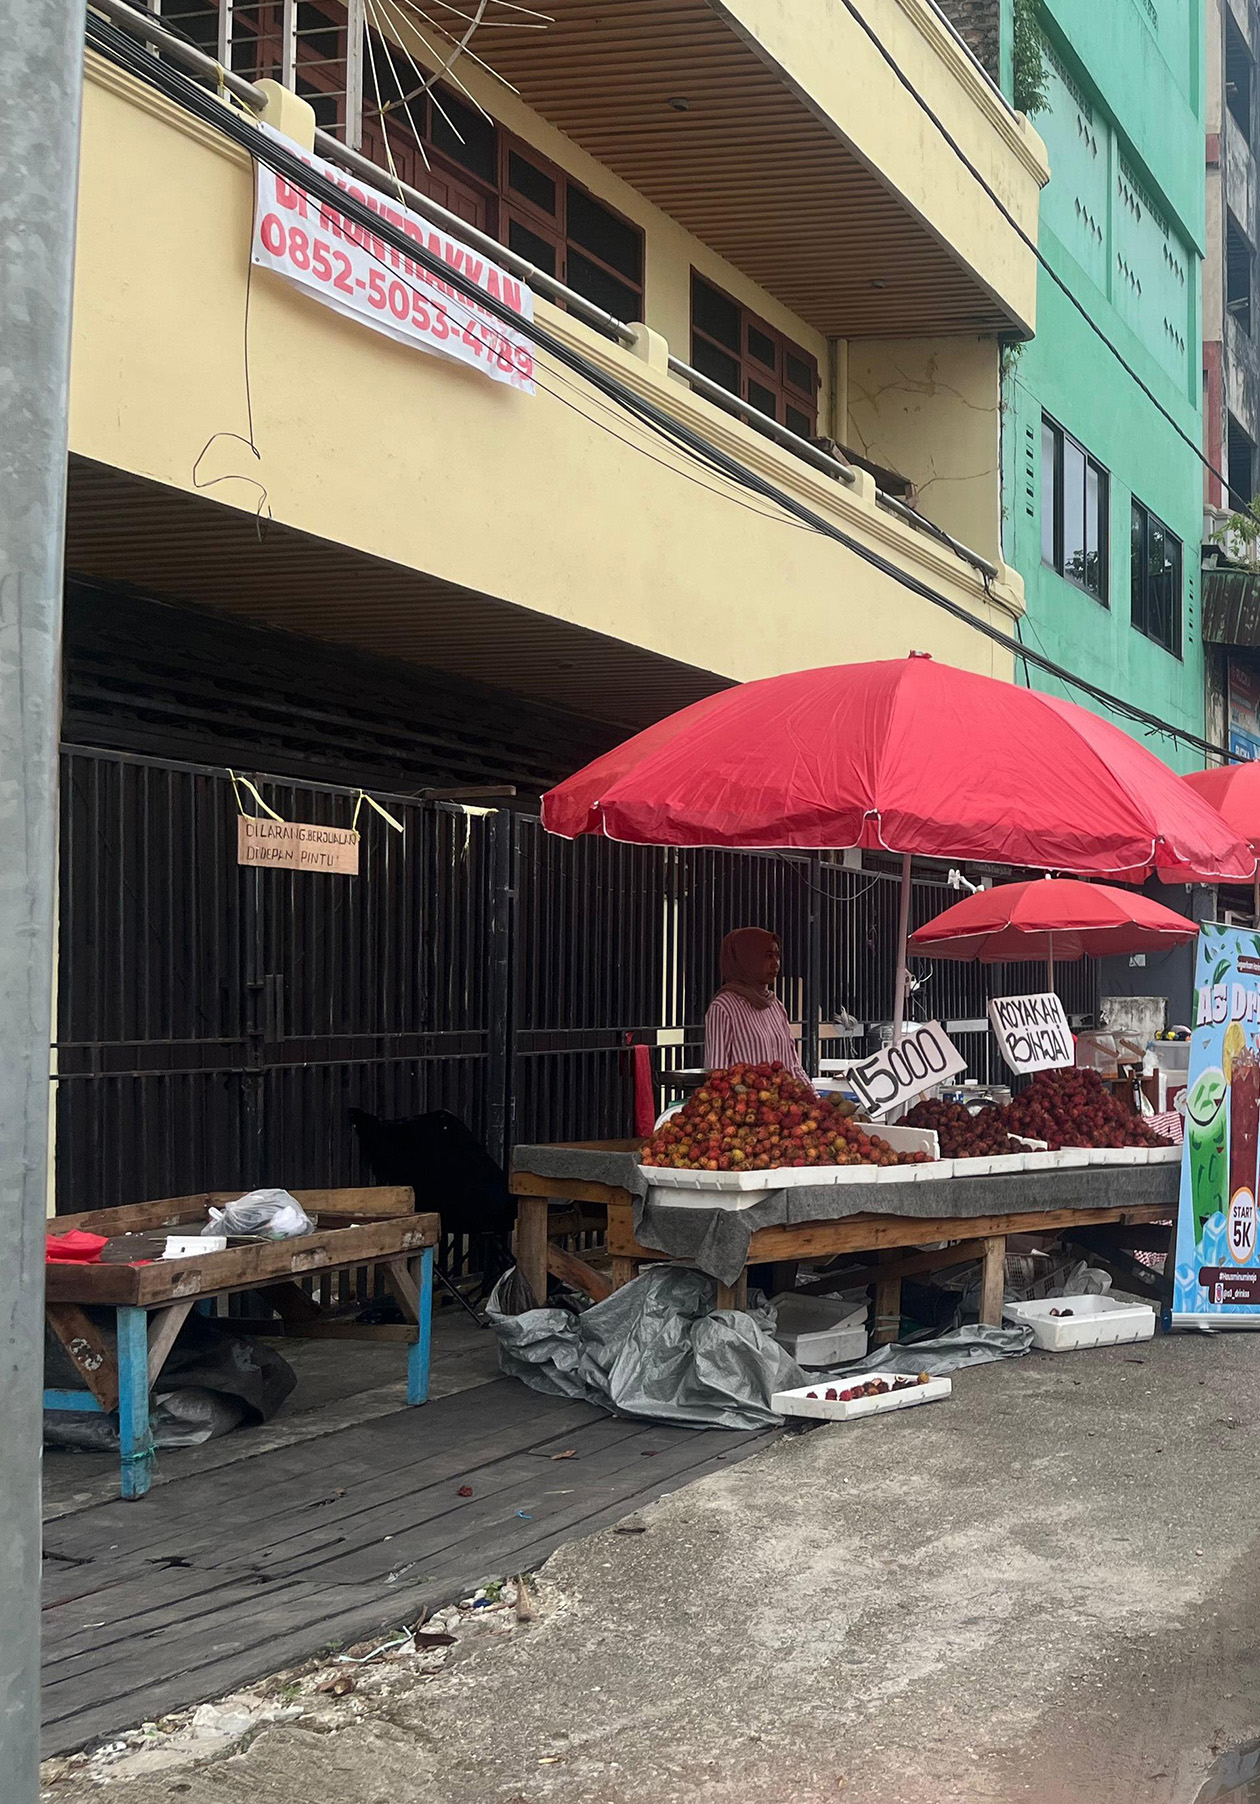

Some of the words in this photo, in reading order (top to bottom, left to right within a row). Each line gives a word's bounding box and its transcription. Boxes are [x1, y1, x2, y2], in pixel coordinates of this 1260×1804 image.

[275, 146, 311, 219] DI
[300, 850, 334, 867] PINTU
[995, 997, 1062, 1031] KOYAKAN
[846, 1028, 947, 1114] 15000
[1233, 1206, 1253, 1218] START
[1233, 1220, 1252, 1247] 5K
